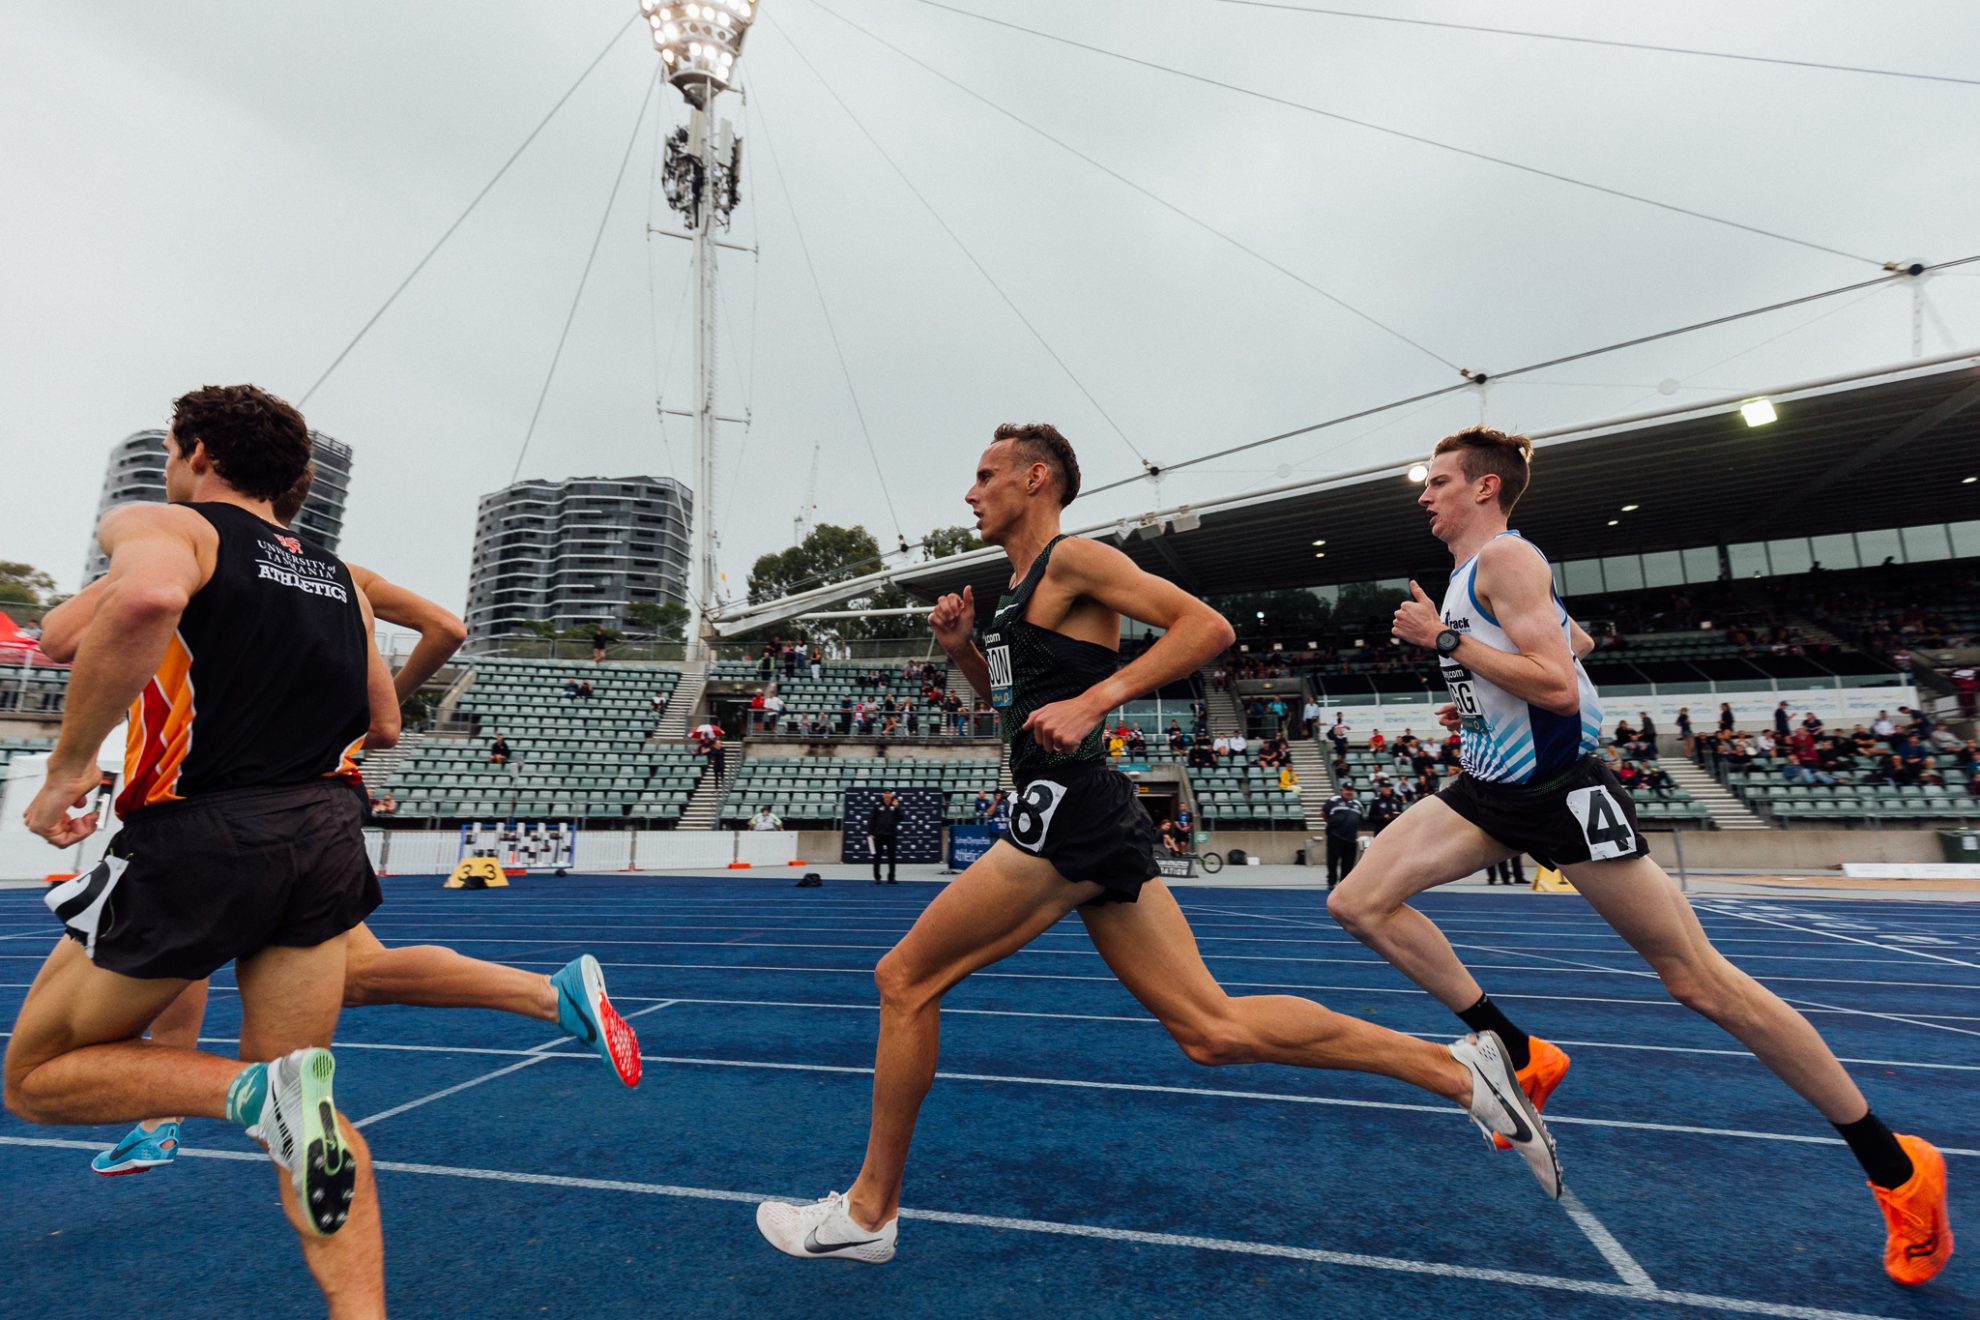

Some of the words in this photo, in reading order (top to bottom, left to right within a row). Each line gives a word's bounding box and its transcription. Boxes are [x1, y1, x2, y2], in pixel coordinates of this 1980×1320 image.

[257, 540, 325, 570] UNIVERSITY
[327, 565, 336, 574] of
[265, 550, 334, 579] TASMANIA
[258, 564, 347, 604] ATHLETICS
[1010, 784, 1054, 845] 8
[1586, 789, 1632, 852] 4
[458, 864, 472, 881] 3
[484, 863, 497, 880] 3
